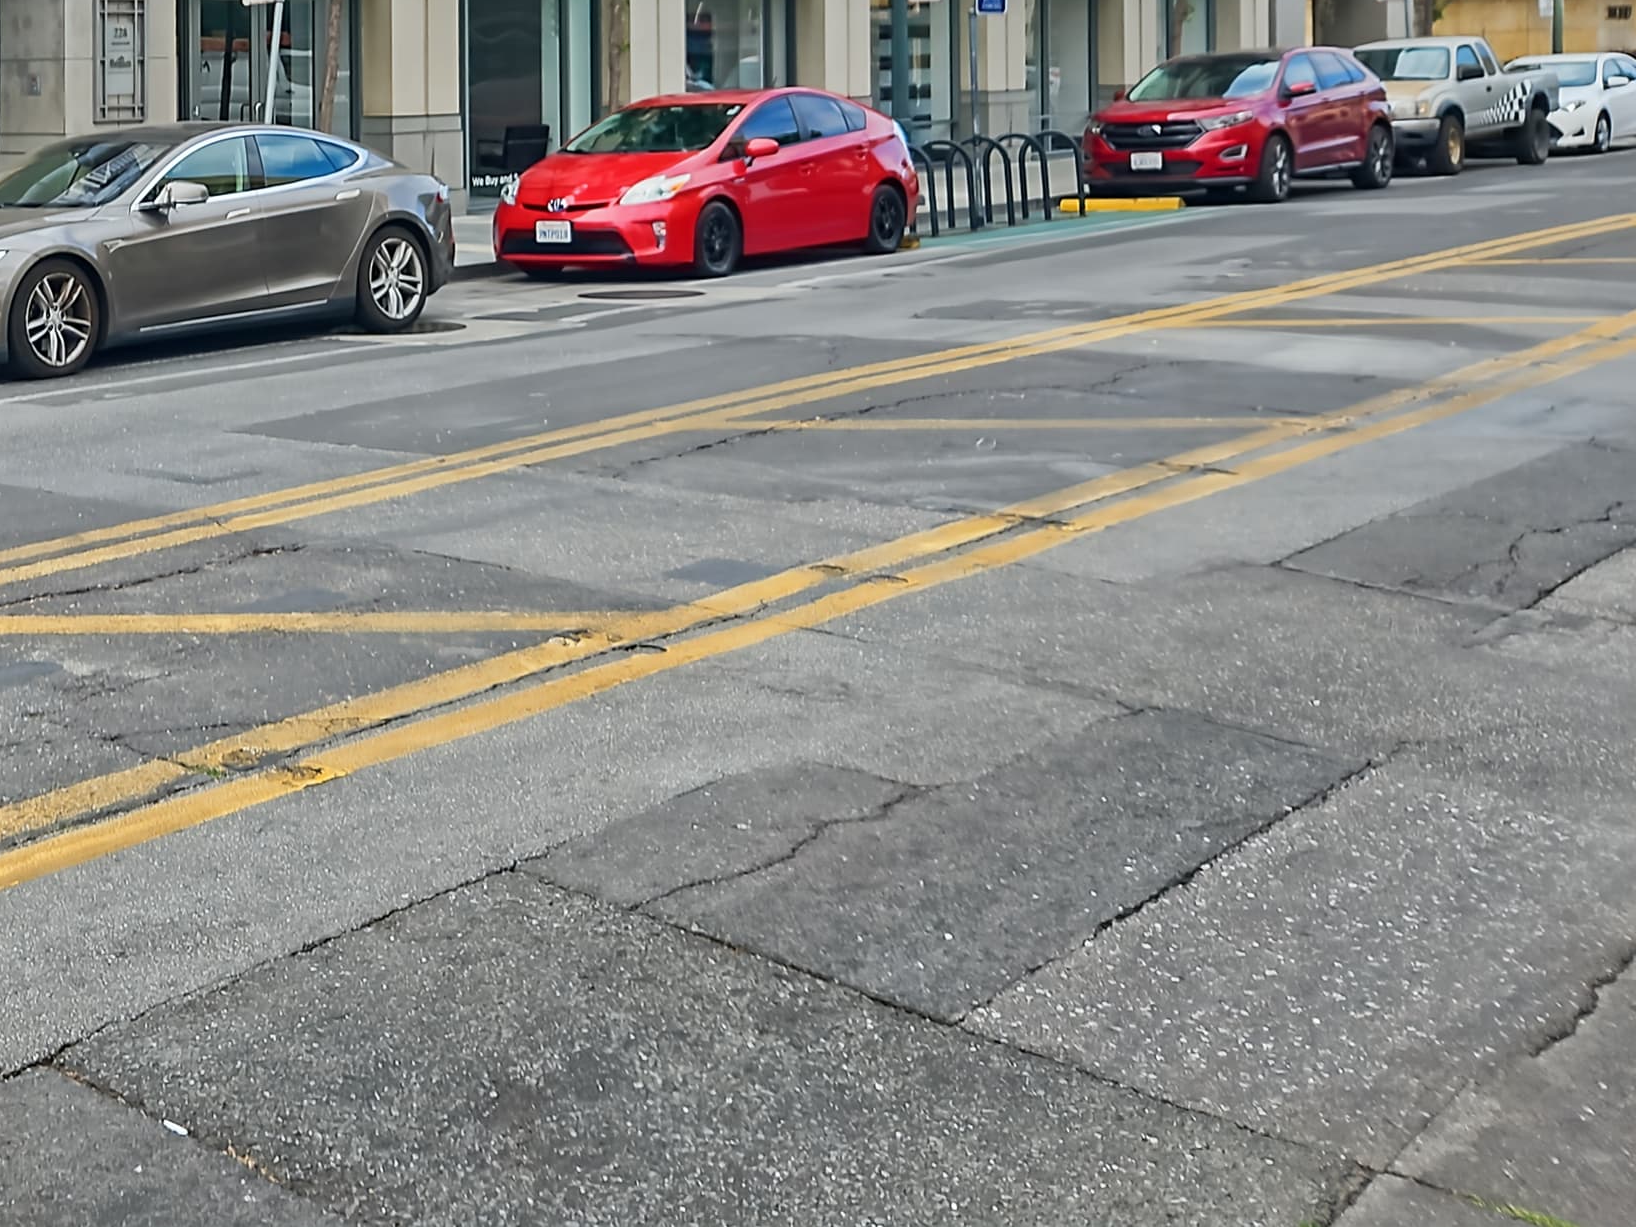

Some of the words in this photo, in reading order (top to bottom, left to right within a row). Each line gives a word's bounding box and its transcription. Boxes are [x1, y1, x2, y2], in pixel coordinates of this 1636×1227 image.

[472, 176, 484, 187] We
[485, 175, 498, 187] Buy
[500, 174, 512, 184] and
